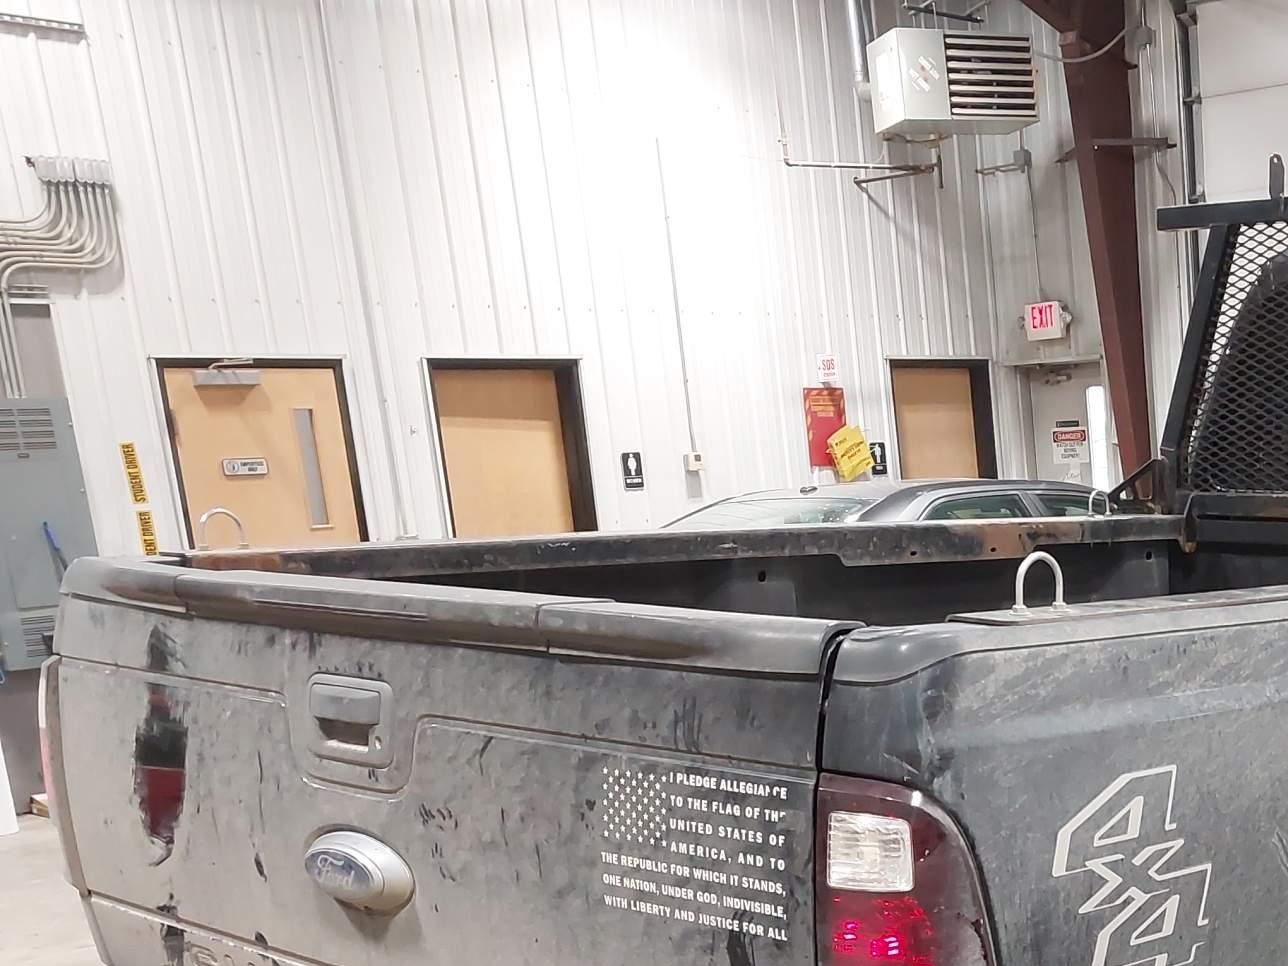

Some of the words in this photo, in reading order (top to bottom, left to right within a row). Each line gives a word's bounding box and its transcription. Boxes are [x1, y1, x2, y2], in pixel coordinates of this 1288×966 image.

[1032, 304, 1053, 328] EXIT
[122, 443, 138, 470] DRIVER
[128, 471, 146, 503] STUDENT
[139, 512, 153, 537] DRIVER
[144, 538, 157, 556] DENT
[670, 772, 674, 783] I
[677, 773, 717, 789] PLEDGE
[670, 795, 683, 807] TO
[687, 798, 707, 811] THE
[712, 802, 740, 816] FLAG
[745, 807, 760, 819] OF
[670, 818, 712, 834] UNITED
[718, 826, 762, 843] STATES
[769, 834, 785, 847] OF
[671, 841, 731, 864] AMERICA,
[738, 852, 763, 867] AND
[770, 858, 785, 870] TO
[316, 854, 356, 890] Ford
[601, 852, 618, 864] THE
[621, 855, 667, 873] REPUBLIC
[670, 864, 690, 877] FOR
[693, 868, 726, 884] WHICH
[730, 875, 738, 886] IT
[742, 877, 786, 897] STANDS,
[603, 874, 621, 886] ONE
[624, 877, 659, 896] NATION,
[662, 884, 694, 900] UNDER
[697, 891, 720, 908] GOD,
[723, 896, 786, 920] INDIVISIBLE,
[604, 895, 627, 908] WITH
[631, 900, 670, 917] LIBERTY
[674, 909, 695, 922] AND
[699, 913, 740, 931] JUSTICE
[743, 922, 764, 936] FOR
[768, 927, 787, 941] ALL
